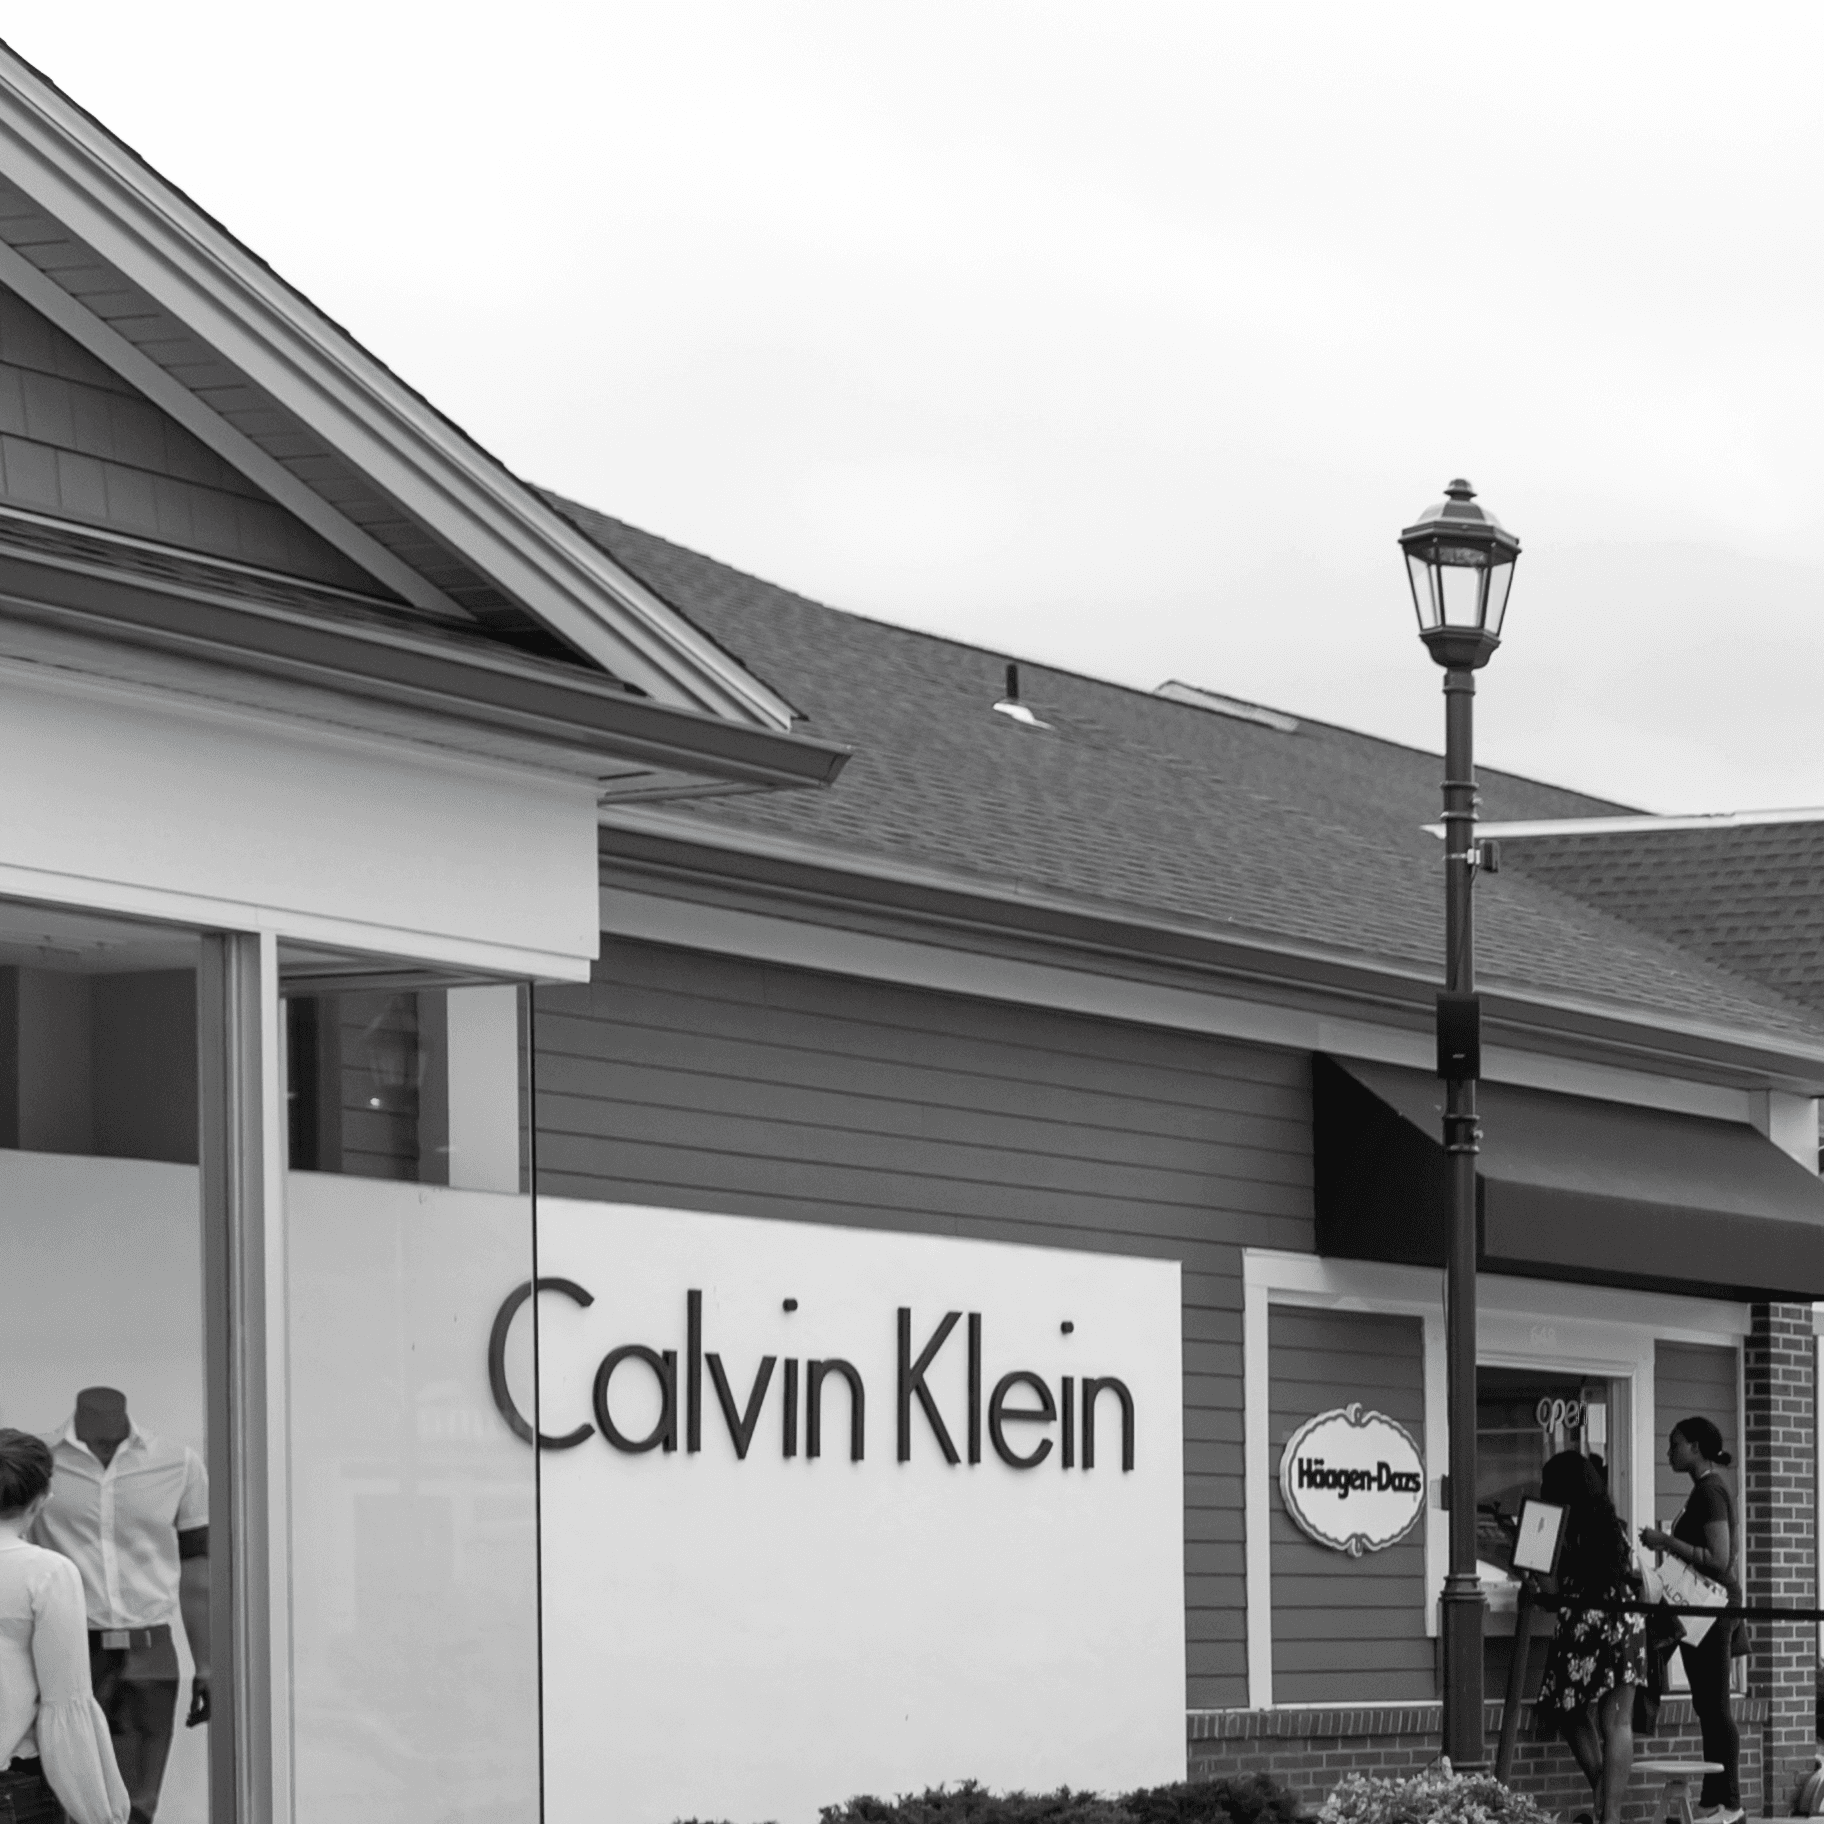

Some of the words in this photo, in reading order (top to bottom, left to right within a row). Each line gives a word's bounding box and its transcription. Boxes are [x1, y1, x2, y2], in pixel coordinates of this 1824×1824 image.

[488, 1277, 865, 1461] Calvin
[897, 1306, 1135, 1472] Klein
[1298, 1457, 1422, 1500] Häagen-Dazs
